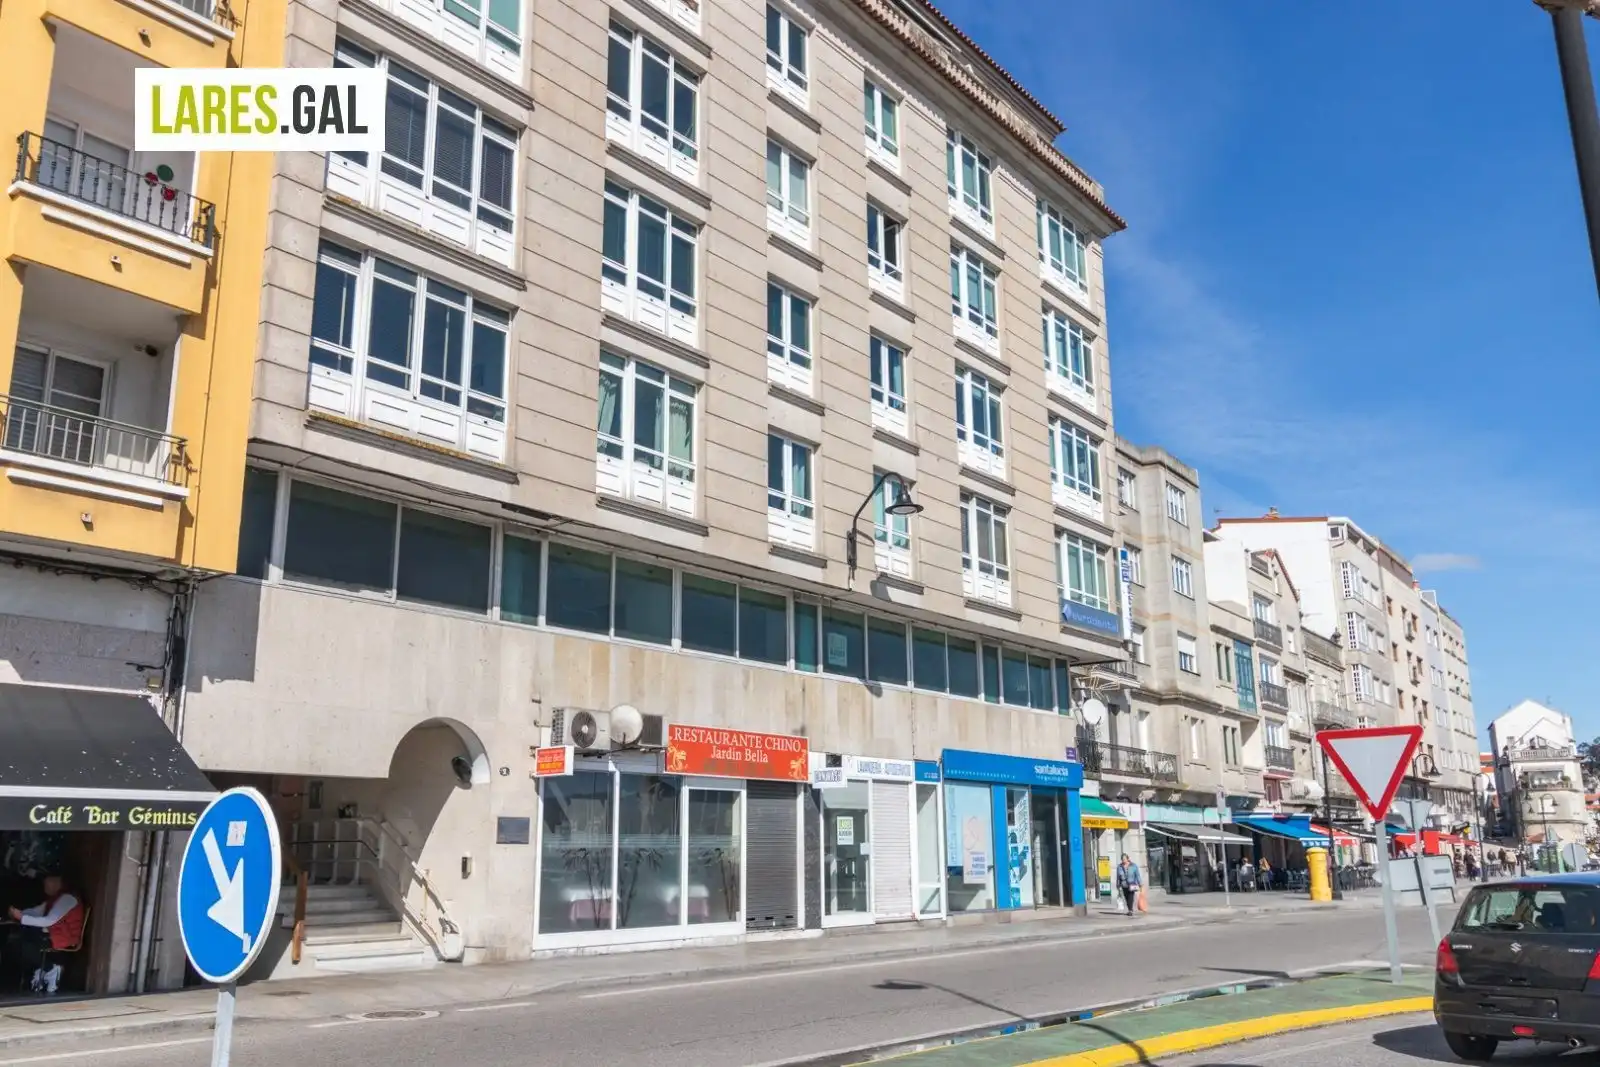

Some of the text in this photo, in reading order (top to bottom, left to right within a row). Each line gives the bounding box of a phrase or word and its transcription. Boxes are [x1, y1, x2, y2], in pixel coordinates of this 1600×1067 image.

[674, 727, 801, 752] RESTAURANTE CHINO
[744, 749, 769, 763] Bella
[29, 804, 197, 825] Café Bar Géminis
